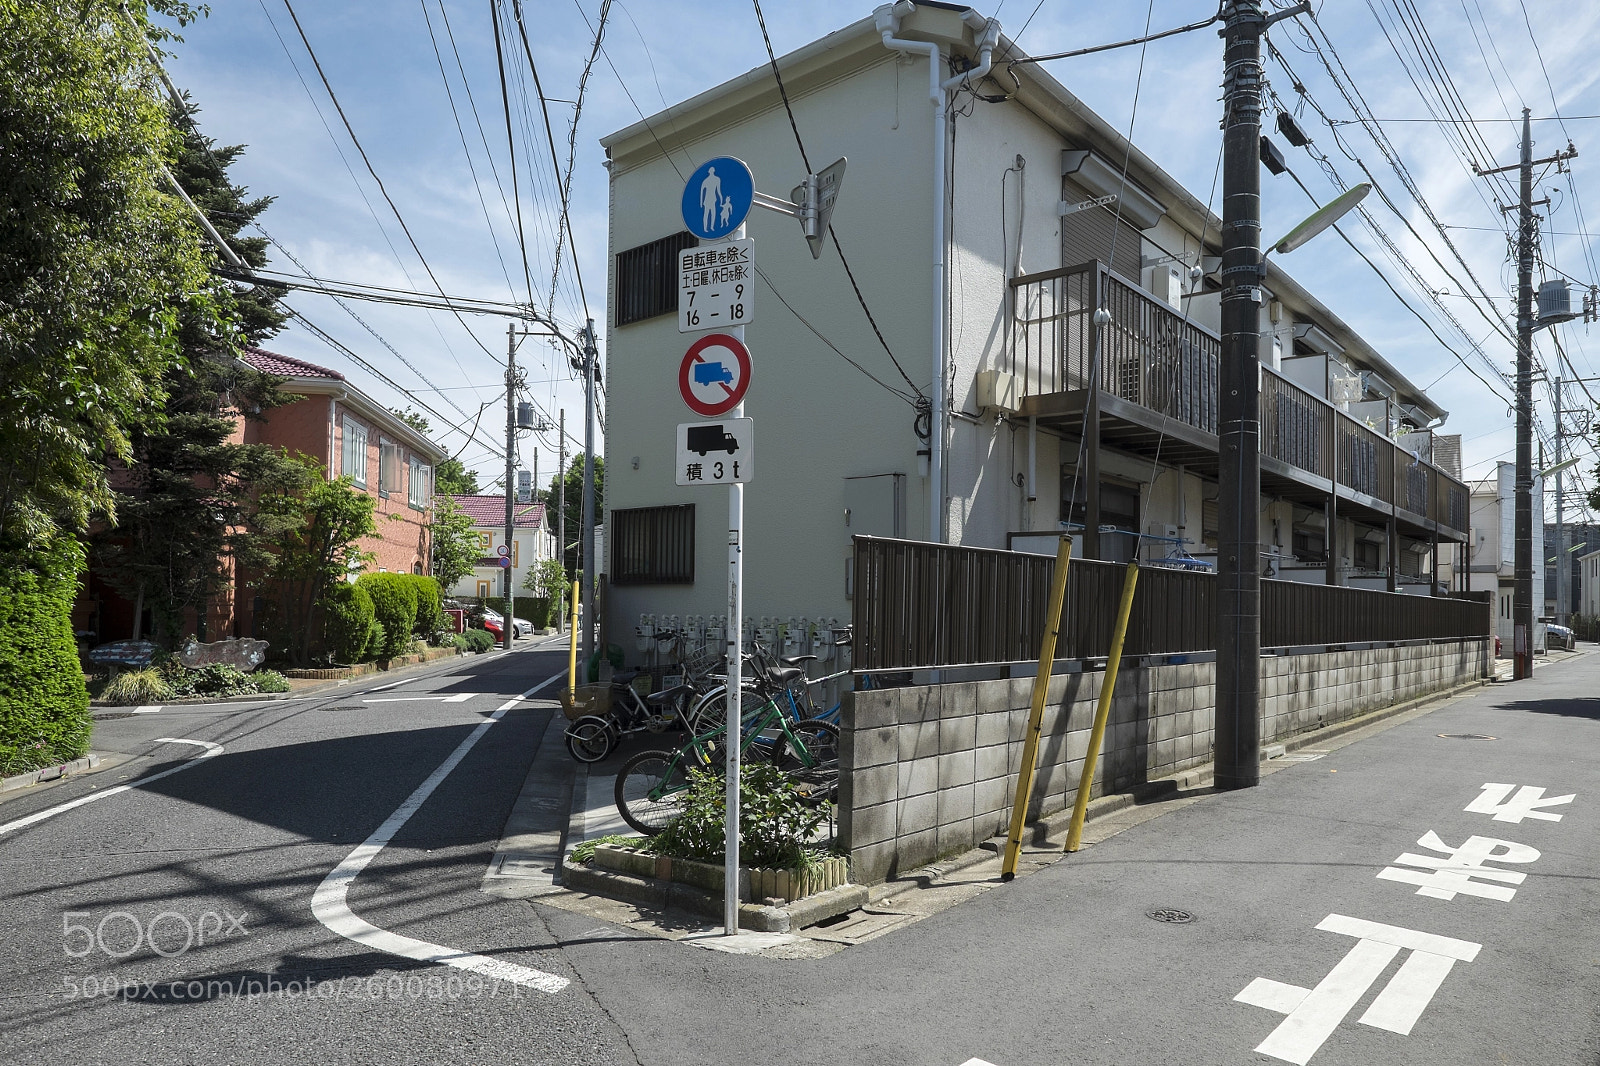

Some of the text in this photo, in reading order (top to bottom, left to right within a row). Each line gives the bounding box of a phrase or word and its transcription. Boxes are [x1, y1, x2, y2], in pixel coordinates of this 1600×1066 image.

[682, 246, 748, 270] 自転車を除く
[687, 291, 696, 308] 7
[736, 284, 745, 300] 9
[687, 310, 700, 327] 16
[731, 303, 745, 321] 18
[687, 462, 703, 481] 積
